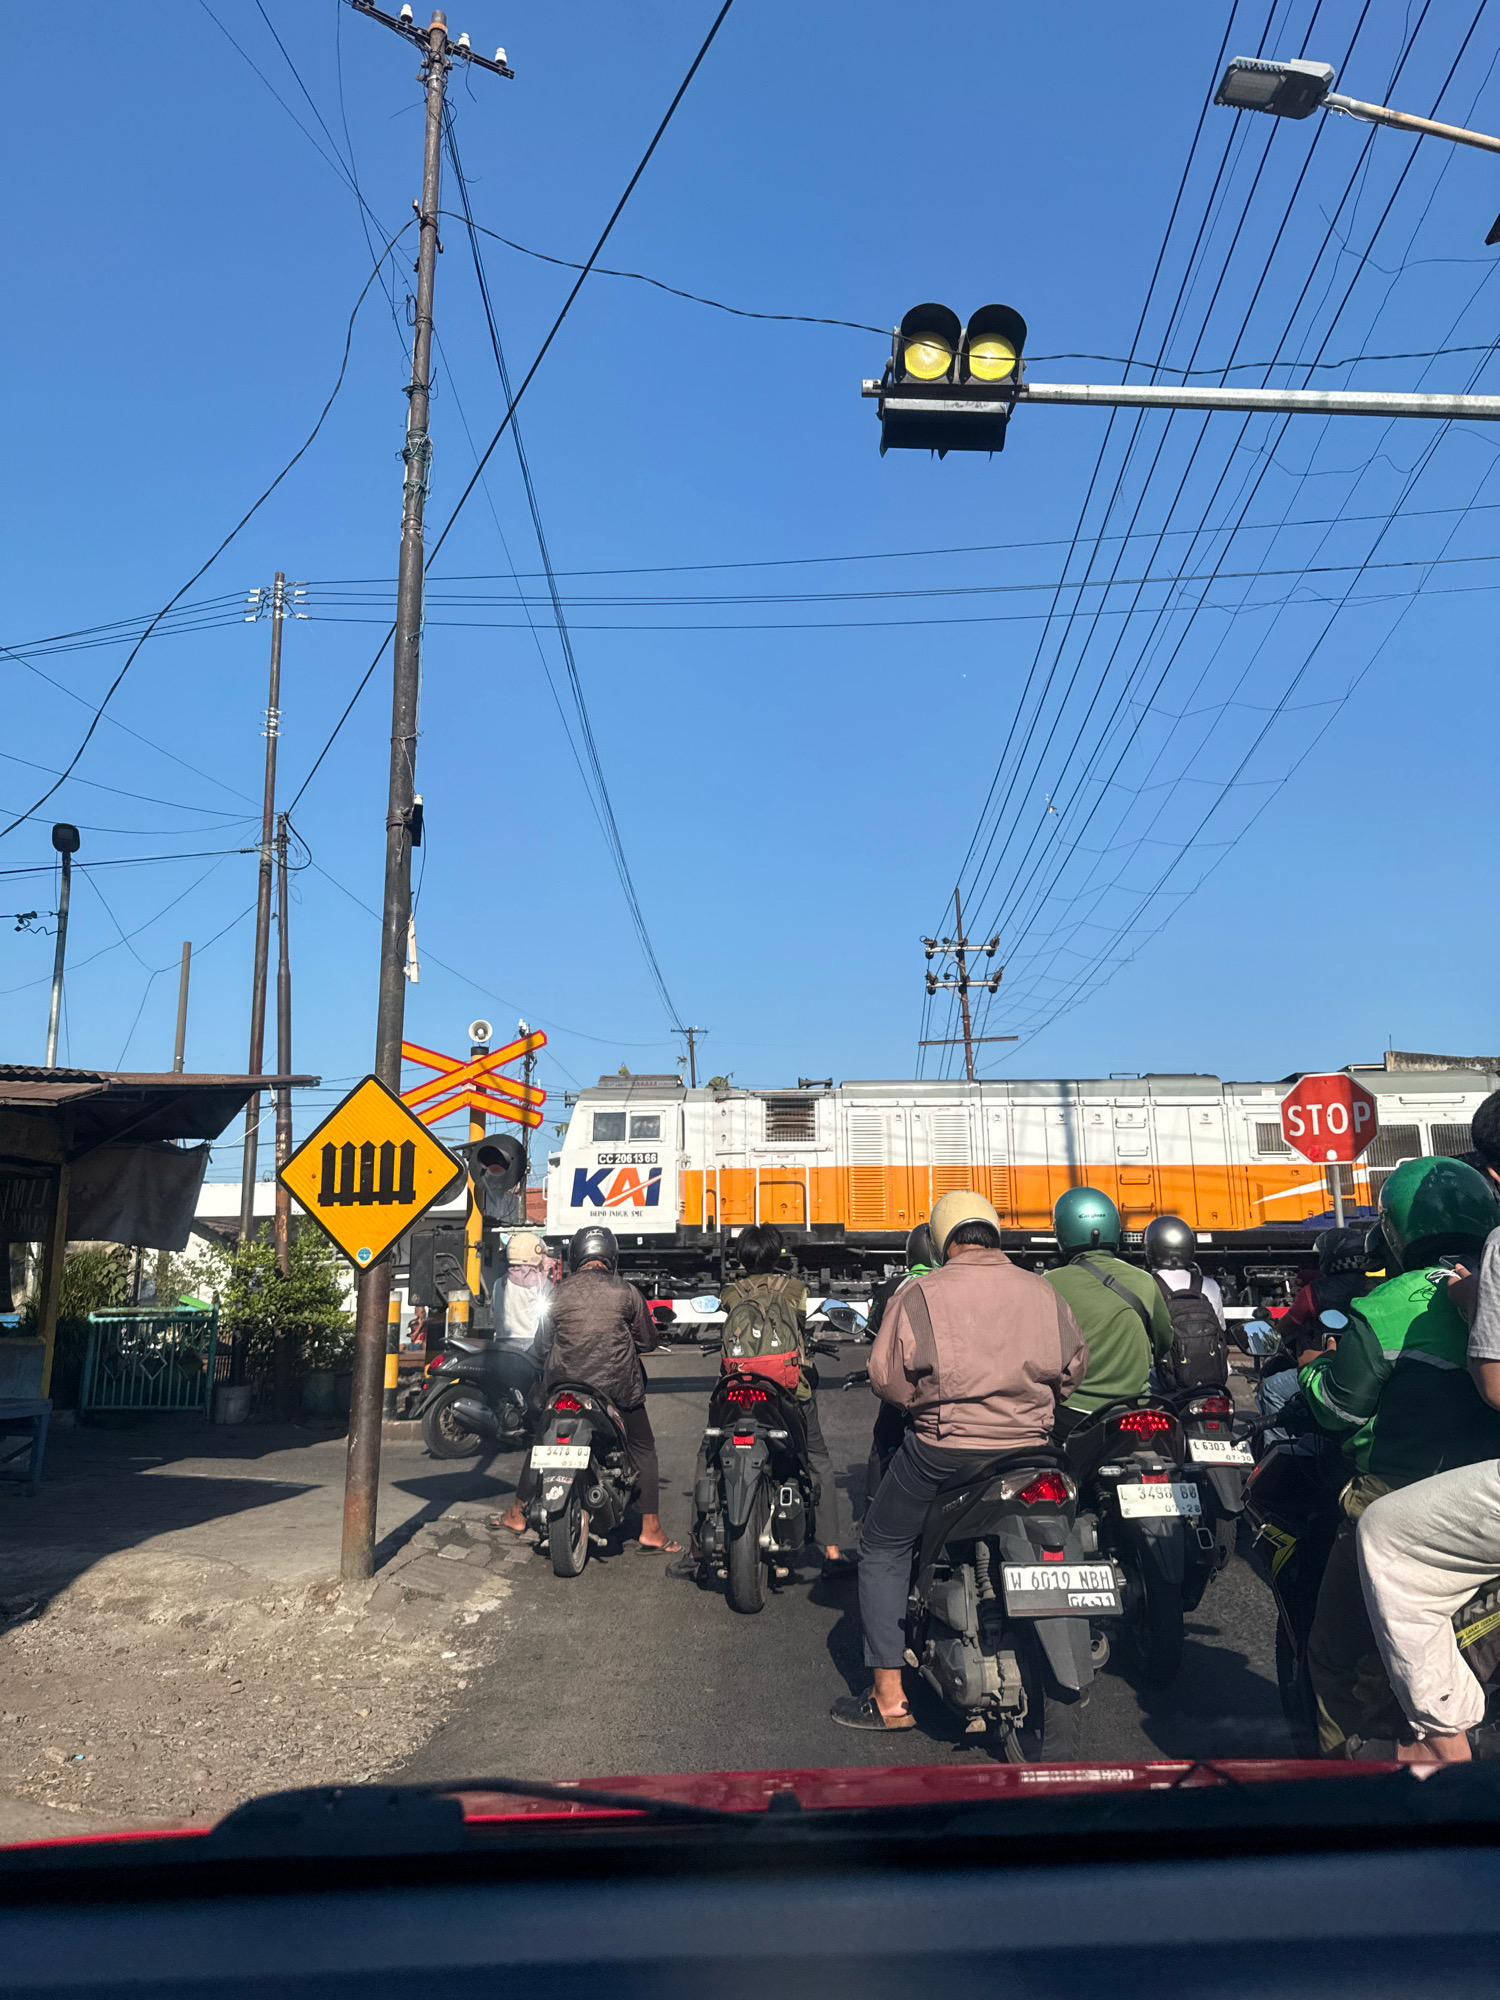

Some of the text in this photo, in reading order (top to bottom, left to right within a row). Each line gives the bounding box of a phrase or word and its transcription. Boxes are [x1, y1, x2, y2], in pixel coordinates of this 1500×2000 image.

[1287, 1101, 1371, 1137] STOP
[599, 1154, 614, 1164] CC
[570, 1167, 663, 1207] KAI
[1202, 1441, 1226, 1451] 6303
[1120, 1487, 1128, 1500] L
[1011, 1571, 1111, 1590] W 6019 NBH
